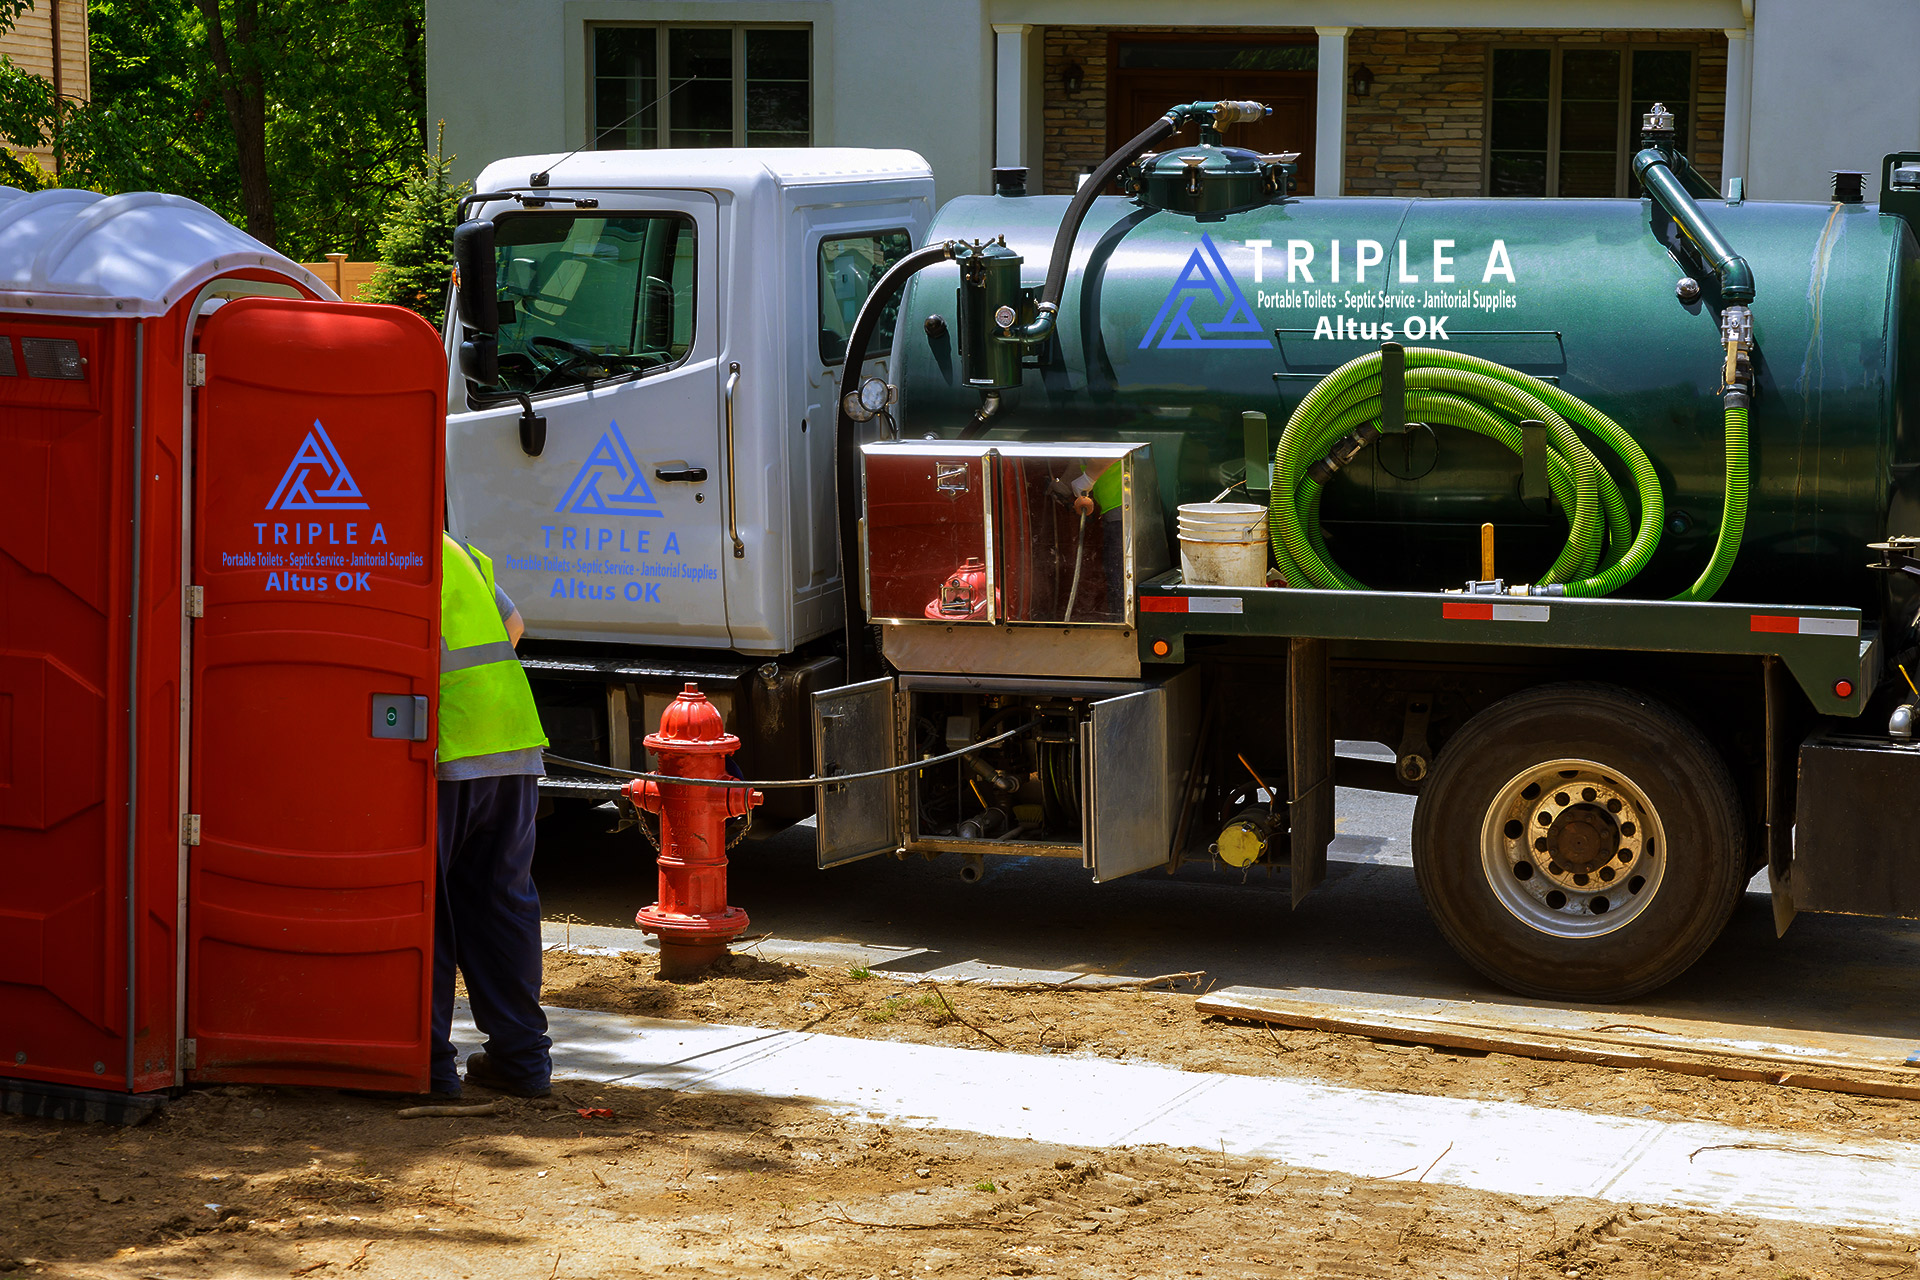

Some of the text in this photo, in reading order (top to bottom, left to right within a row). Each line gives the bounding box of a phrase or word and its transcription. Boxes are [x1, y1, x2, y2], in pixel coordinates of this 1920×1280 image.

[1245, 239, 1516, 283] TRIPLE A
[1257, 289, 1302, 308] Portable
[1303, 289, 1337, 308] Toilets
[1344, 289, 1376, 313] Septic
[1378, 289, 1415, 308] Service
[1422, 289, 1471, 308] Janitorial
[1473, 289, 1517, 313] Supplies
[1314, 315, 1449, 340] Altus OK
[254, 523, 388, 545] TRIPLE A
[541, 525, 681, 556] TRIPLE A
[222, 551, 256, 567] Portable
[257, 551, 284, 567] Toilets
[289, 551, 314, 570] Septic
[315, 551, 344, 567] Service
[350, 551, 388, 567] Janitorial
[389, 551, 424, 570] Supplies
[506, 554, 542, 571] Portable
[543, 556, 570, 573] Toilets
[576, 558, 603, 577] Septic
[604, 559, 634, 576] Service
[640, 562, 681, 578] Janitorial
[682, 563, 718, 583] Supplies
[265, 572, 371, 591] Altus OK
[549, 577, 662, 604] Altus OK
